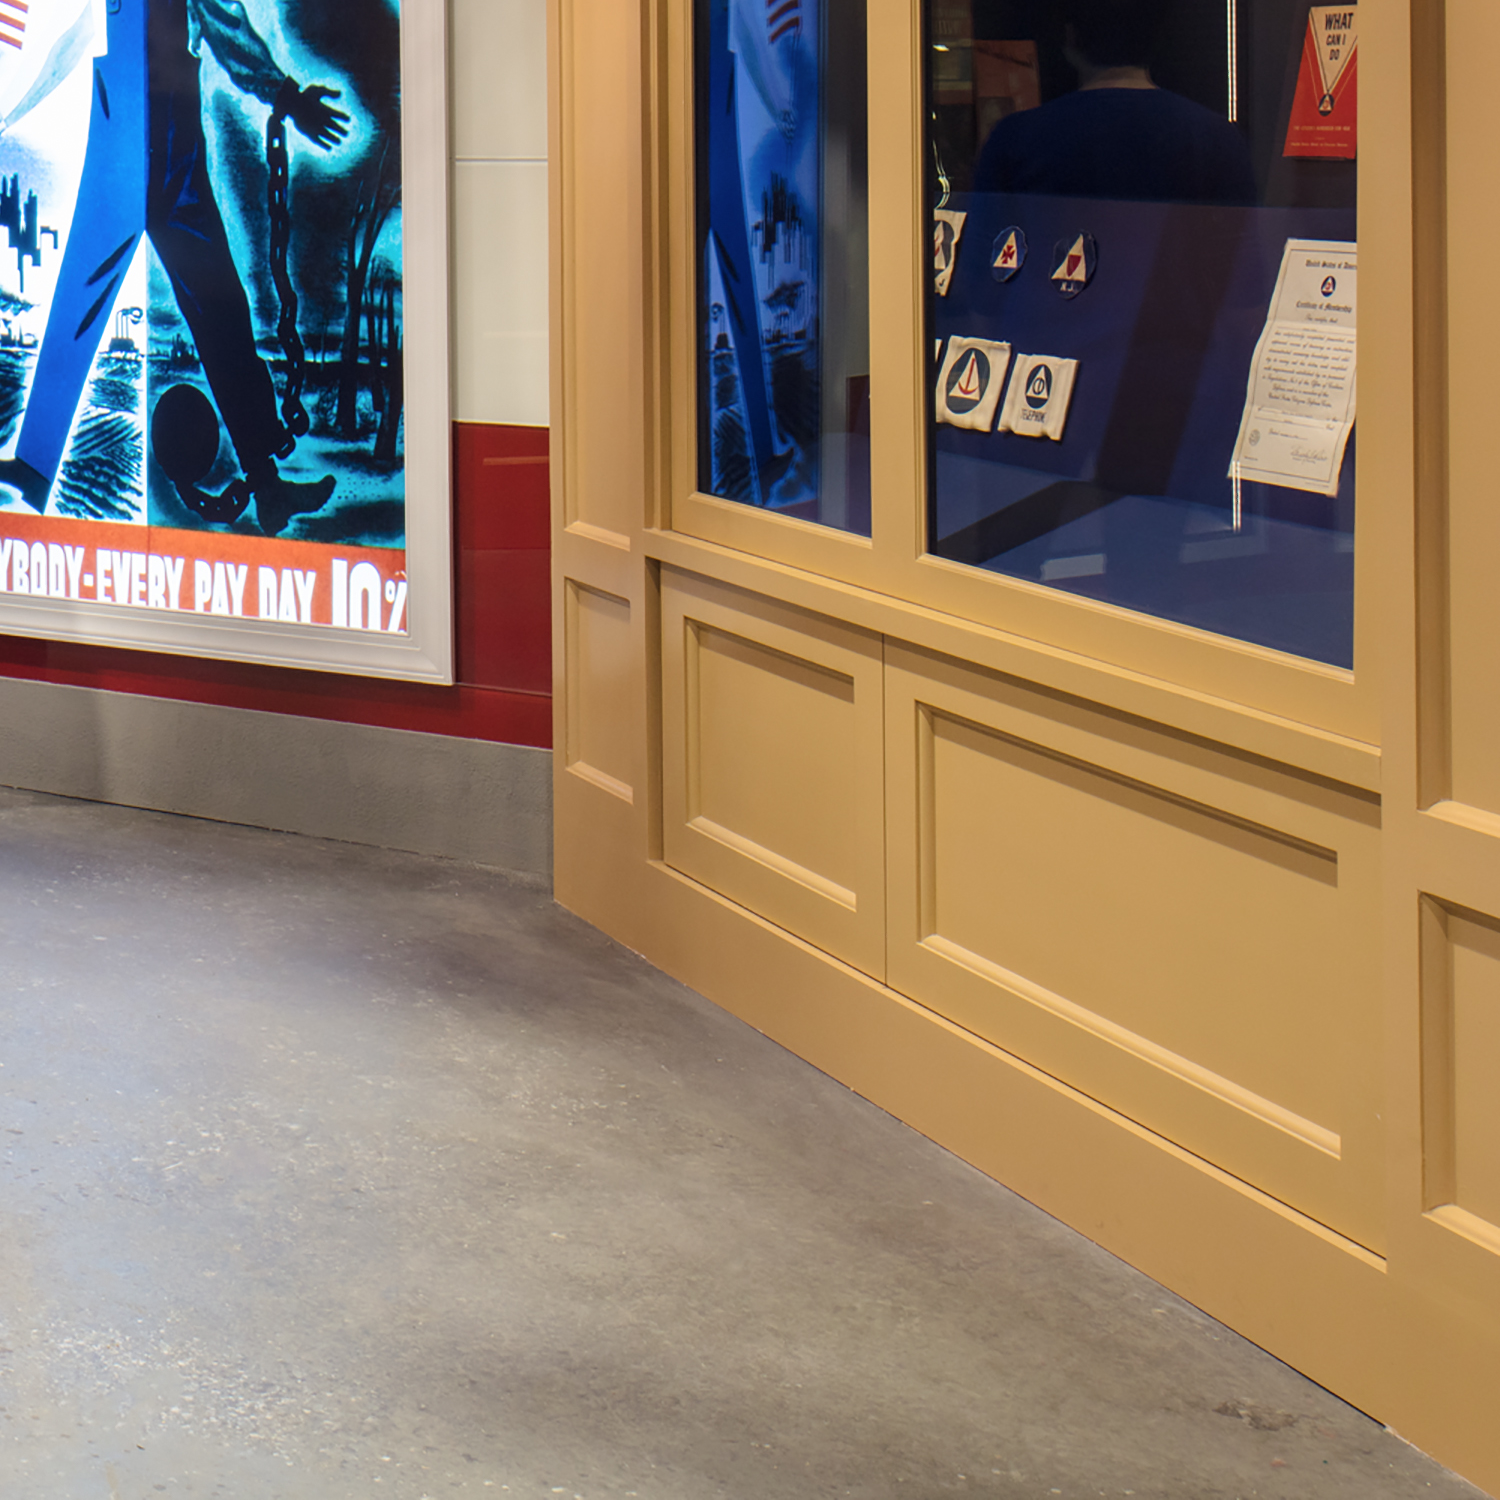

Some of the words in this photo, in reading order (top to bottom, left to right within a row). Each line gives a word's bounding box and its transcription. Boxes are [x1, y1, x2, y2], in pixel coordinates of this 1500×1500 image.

[1325, 12, 1354, 31] WHAT
[1326, 34, 1341, 46] CAN
[1342, 34, 1347, 46] I
[1329, 49, 1340, 61] DO
[194, 559, 248, 618] PAY
[257, 565, 317, 625] DAY
